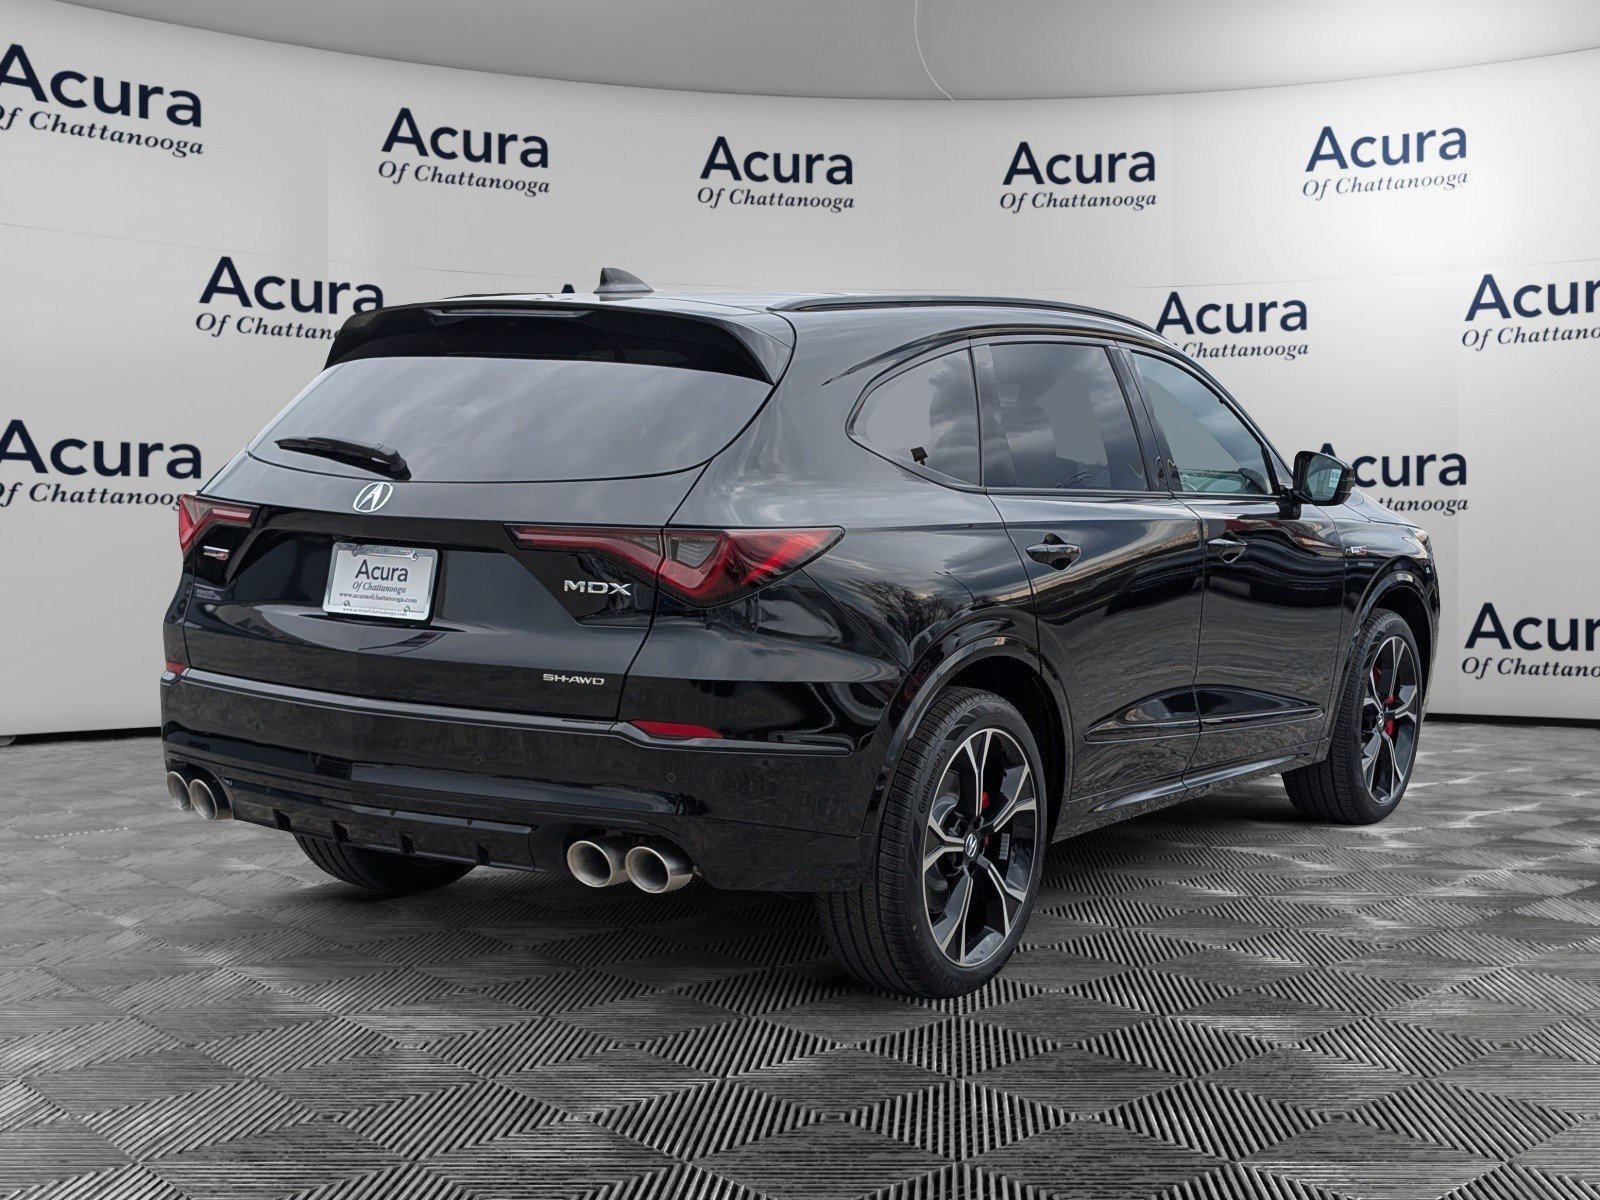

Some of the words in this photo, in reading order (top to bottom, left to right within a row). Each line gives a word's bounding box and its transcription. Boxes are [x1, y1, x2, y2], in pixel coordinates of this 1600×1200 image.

[0, 44, 202, 127] Acura
[29, 111, 204, 157] Chattanooga
[381, 107, 549, 168] Acura
[1305, 126, 1467, 172] Acura
[378, 160, 410, 185] Of
[414, 165, 550, 197] Chattanooga
[700, 136, 853, 185] Acura
[1003, 141, 1156, 186] Acura
[697, 187, 726, 209] Of
[730, 189, 855, 213] Chattanooga
[1000, 192, 1029, 214] Of
[1032, 191, 1157, 212] Chattanooga
[1302, 179, 1331, 201] Of
[1335, 172, 1468, 195] Chattanooga
[199, 255, 384, 315] Acura
[1465, 274, 1600, 322] Acur
[196, 312, 232, 338] Of
[1155, 291, 1307, 335] Acura
[1462, 327, 1492, 351] Of
[0, 419, 202, 479] Acura
[352, 581, 363, 593] Of
[363, 582, 407, 595] Chattanooga
[355, 559, 408, 582] Acura
[563, 580, 631, 596] MDX
[1464, 602, 1600, 651] Acur
[542, 673, 605, 685] SH-AWD
[1462, 656, 1494, 681] Of
